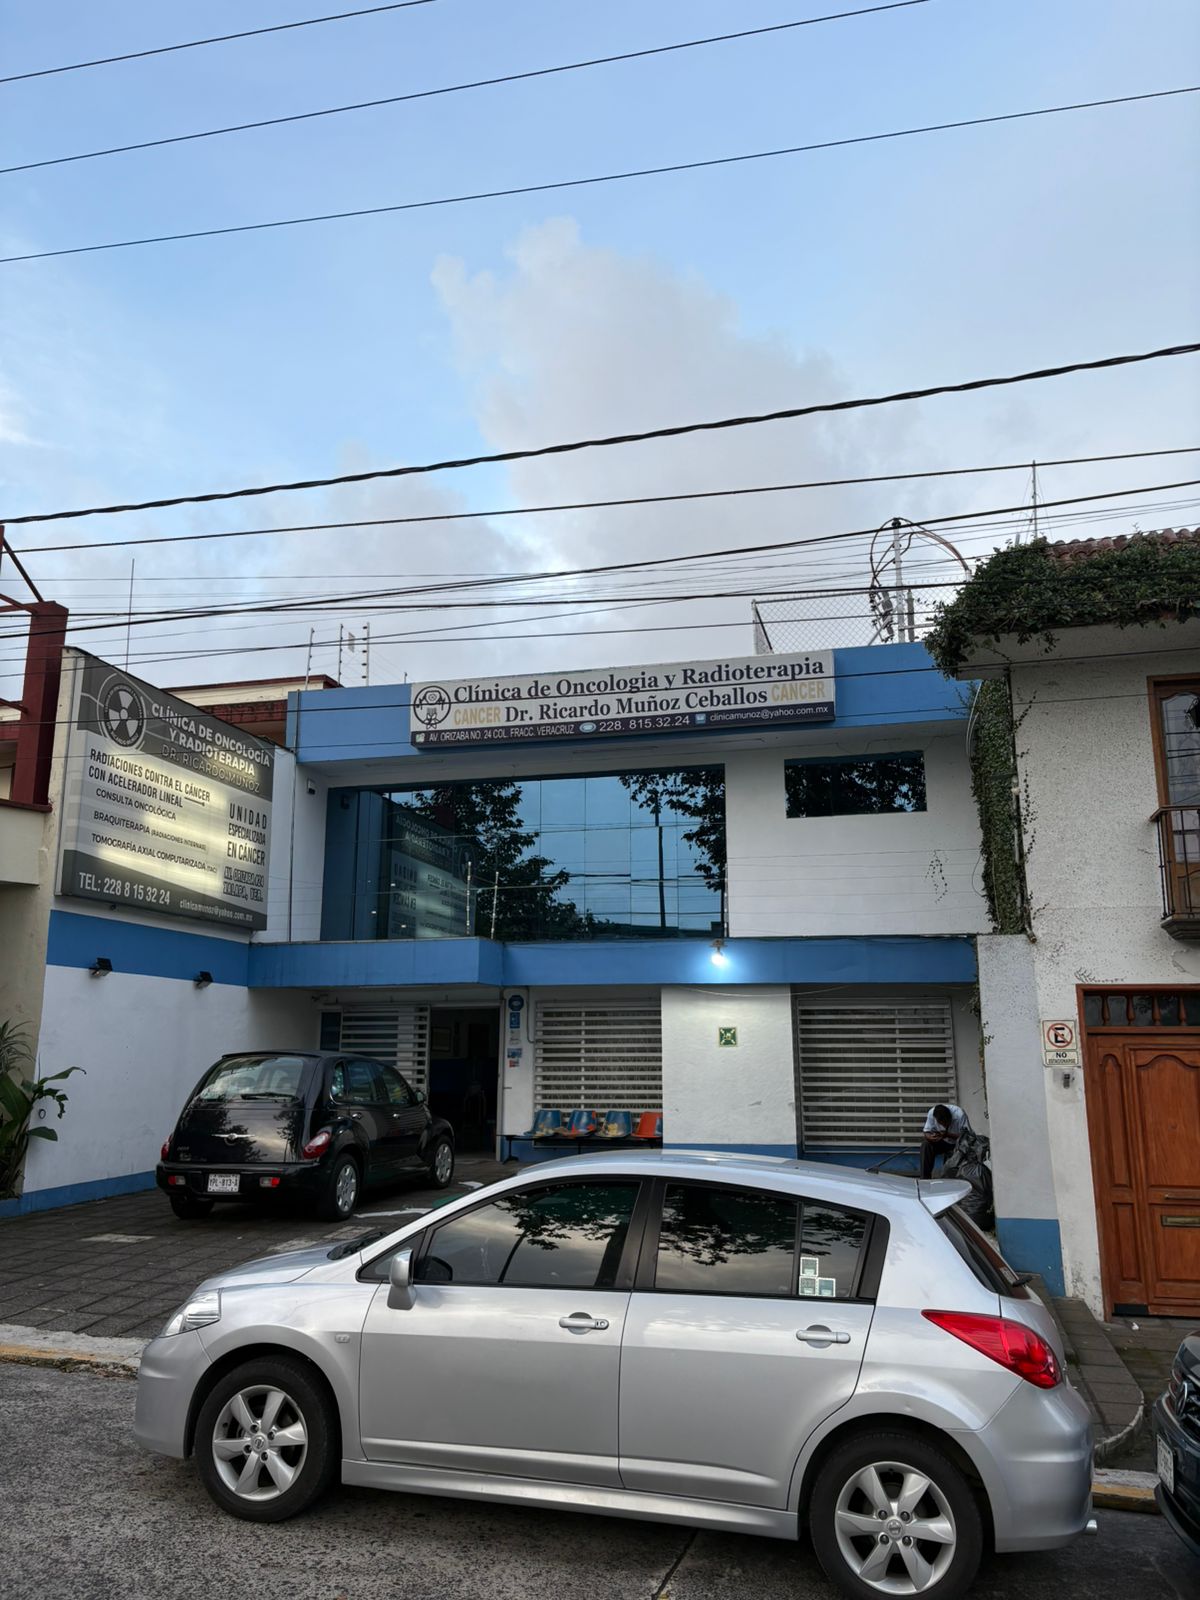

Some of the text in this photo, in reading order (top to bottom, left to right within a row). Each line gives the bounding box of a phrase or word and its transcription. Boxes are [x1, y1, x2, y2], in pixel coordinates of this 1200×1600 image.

[454, 683, 522, 703] Clínica
[527, 680, 550, 698] de
[664, 674, 676, 690] y
[681, 657, 824, 685] Radioterapia
[454, 680, 826, 725] CANCER Dr. Ricardo Muñoz Ceballos CANCER
[151, 703, 197, 735] CLÍNICA
[198, 724, 213, 742] DE
[214, 732, 271, 767] ONCOLOGÍA
[429, 733, 440, 742] AV.
[440, 731, 469, 741] ORIZABA
[483, 729, 493, 739] 24
[510, 726, 534, 737] FRACC.
[536, 724, 575, 736] VERACRUZ
[599, 720, 625, 732] 228.
[629, 715, 690, 729] 815.32.24
[709, 706, 829, 721] clinicamunoz@yahoo.com.mx
[161, 744, 180, 761] DR.
[182, 752, 226, 780] RICARDO
[170, 728, 256, 776] Y RADIOTERAPIA
[88, 765, 183, 808] CON ACELERADOR LINEAL
[90, 748, 211, 802] RADIACIONES CONTRA EL CÁNCER
[93, 811, 151, 834] BRAQUITERAPIA
[95, 788, 177, 821] CONSULTA ONCOLÓGICA
[229, 803, 267, 830] UNIDAD
[91, 833, 137, 852] TOMOGRAFÍA
[137, 845, 156, 858] AXIAL
[156, 851, 206, 871] COMPUTARIZADA
[228, 823, 266, 846] ESPECIALIZADA
[227, 841, 266, 867] EN CÁNCER
[79, 871, 170, 905] TEL: 228 8 15 32 24
